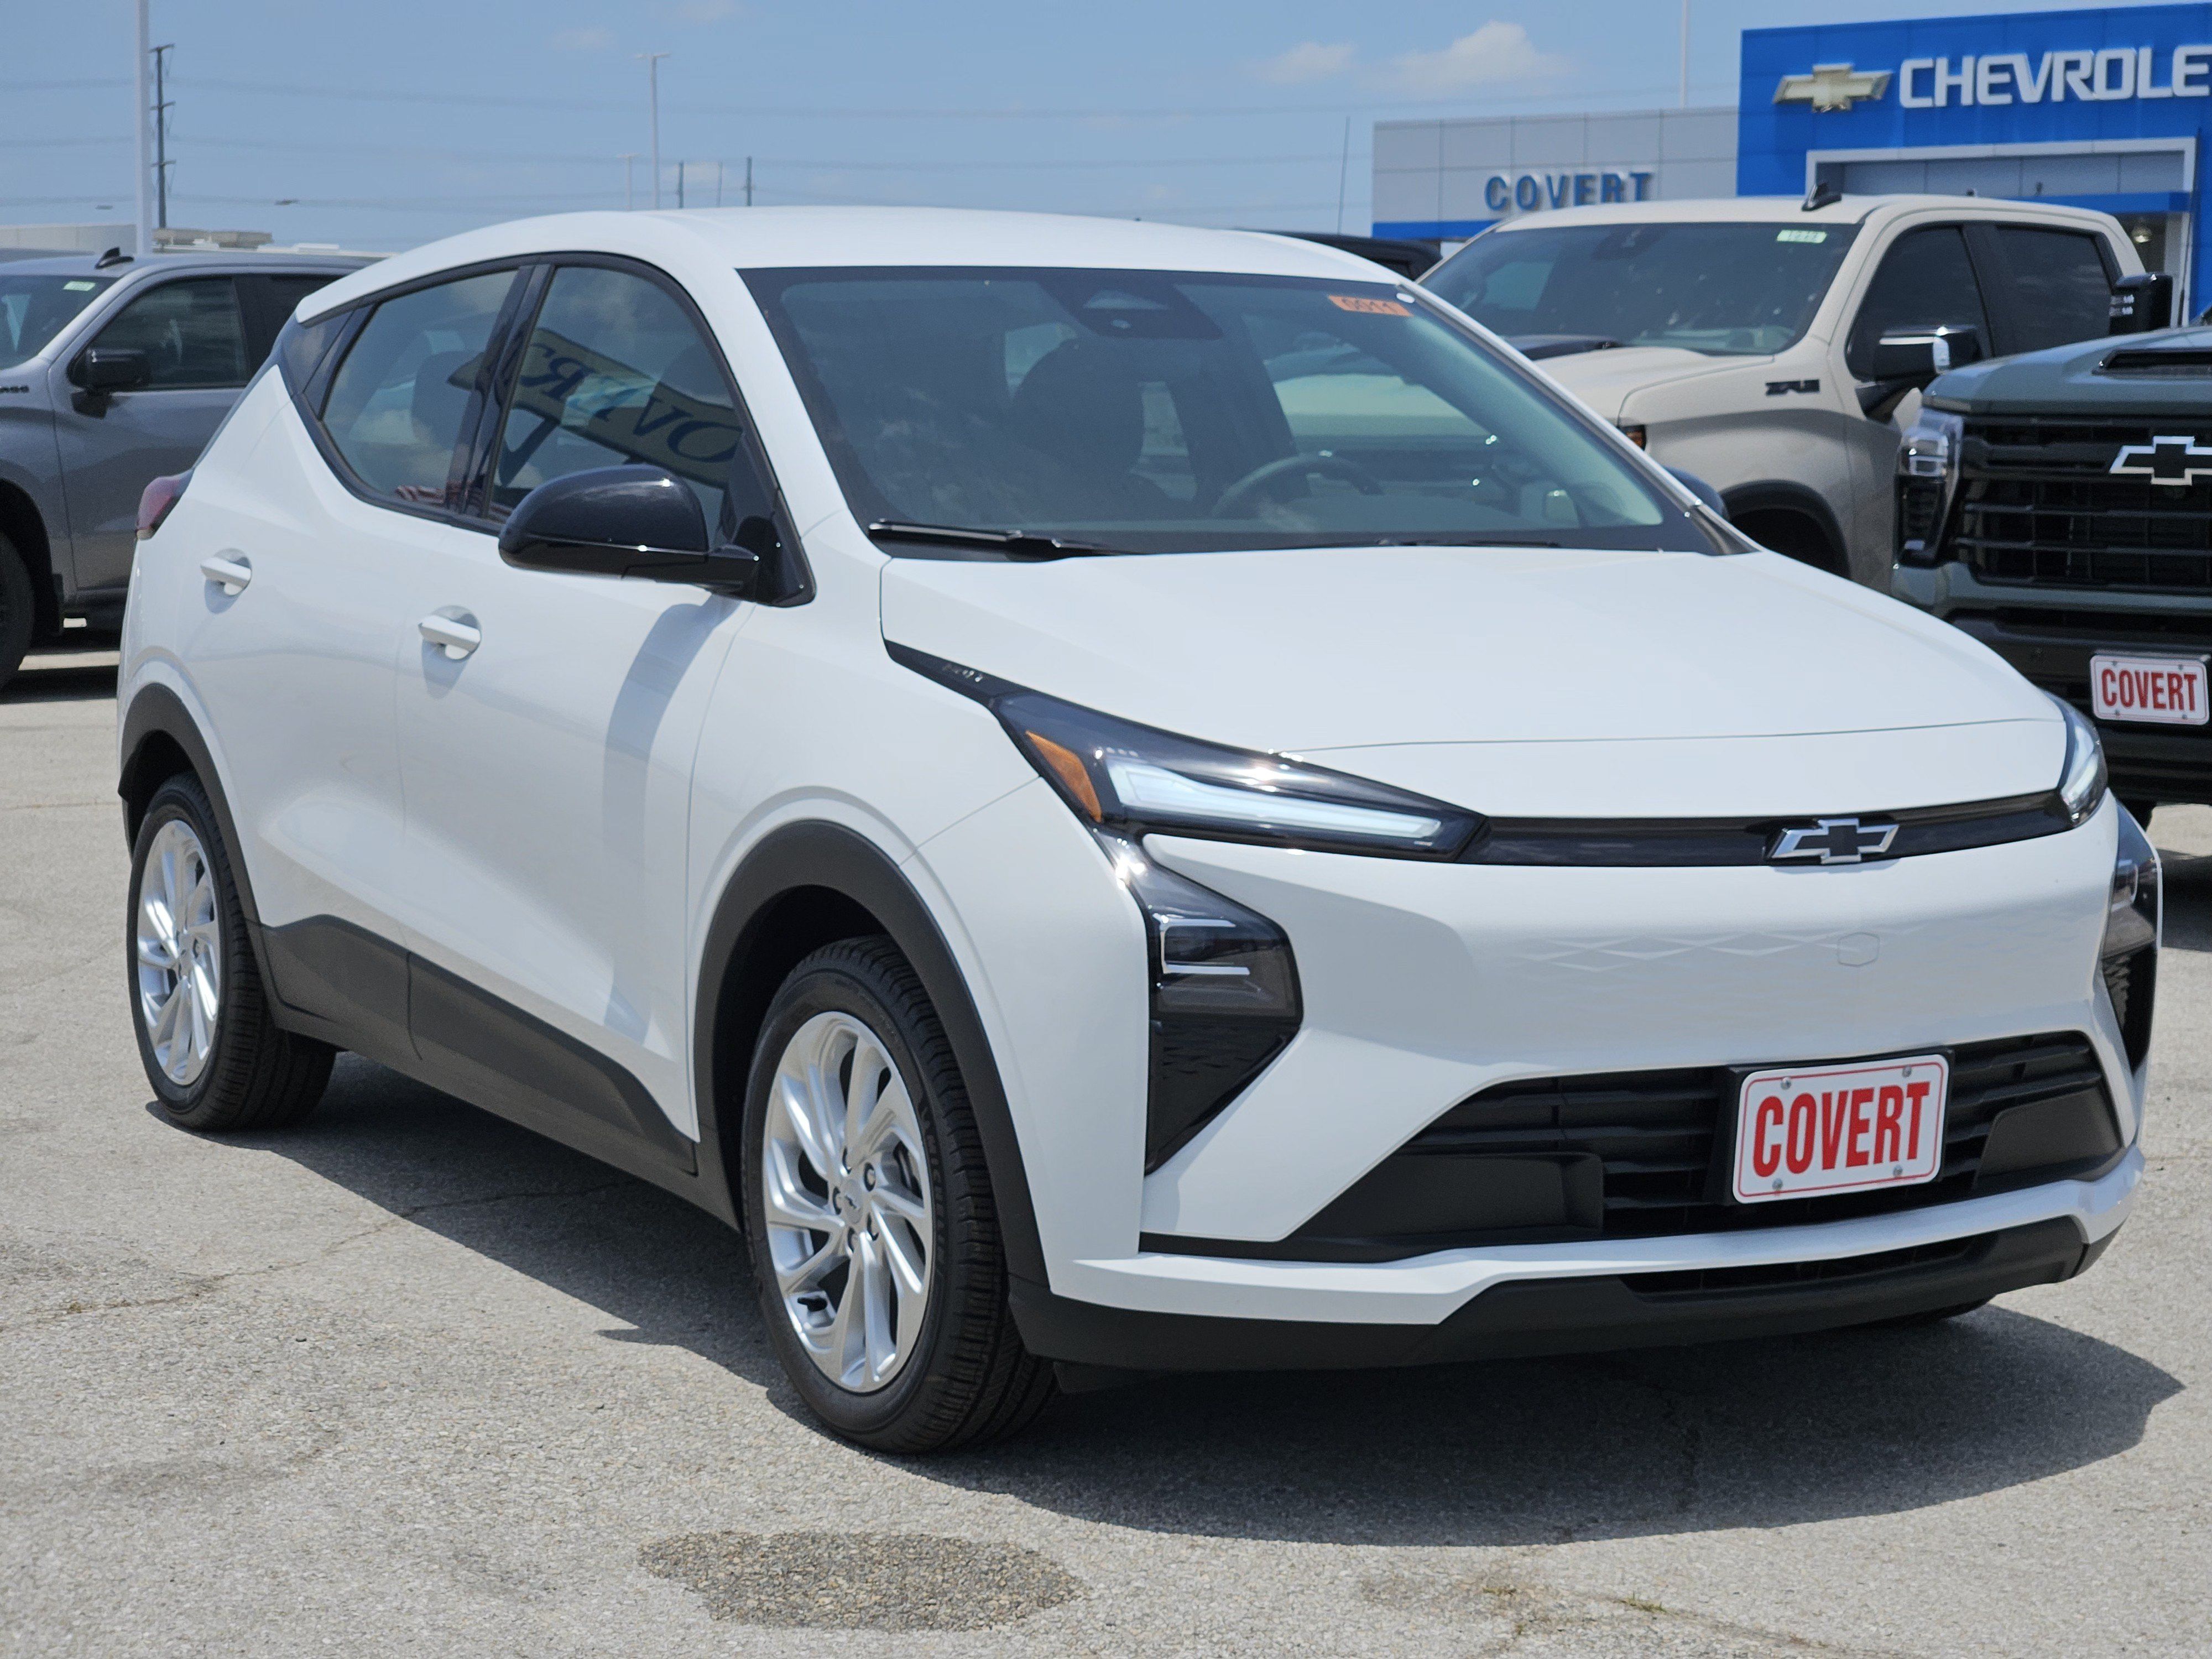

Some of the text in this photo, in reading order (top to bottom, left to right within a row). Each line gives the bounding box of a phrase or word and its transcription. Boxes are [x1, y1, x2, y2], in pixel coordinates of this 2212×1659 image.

[1899, 45, 2212, 108] CHEVROLE
[1485, 171, 1653, 211] COVERT
[2102, 669, 2198, 712] COVERT
[1752, 1081, 1931, 1178] COVERT
